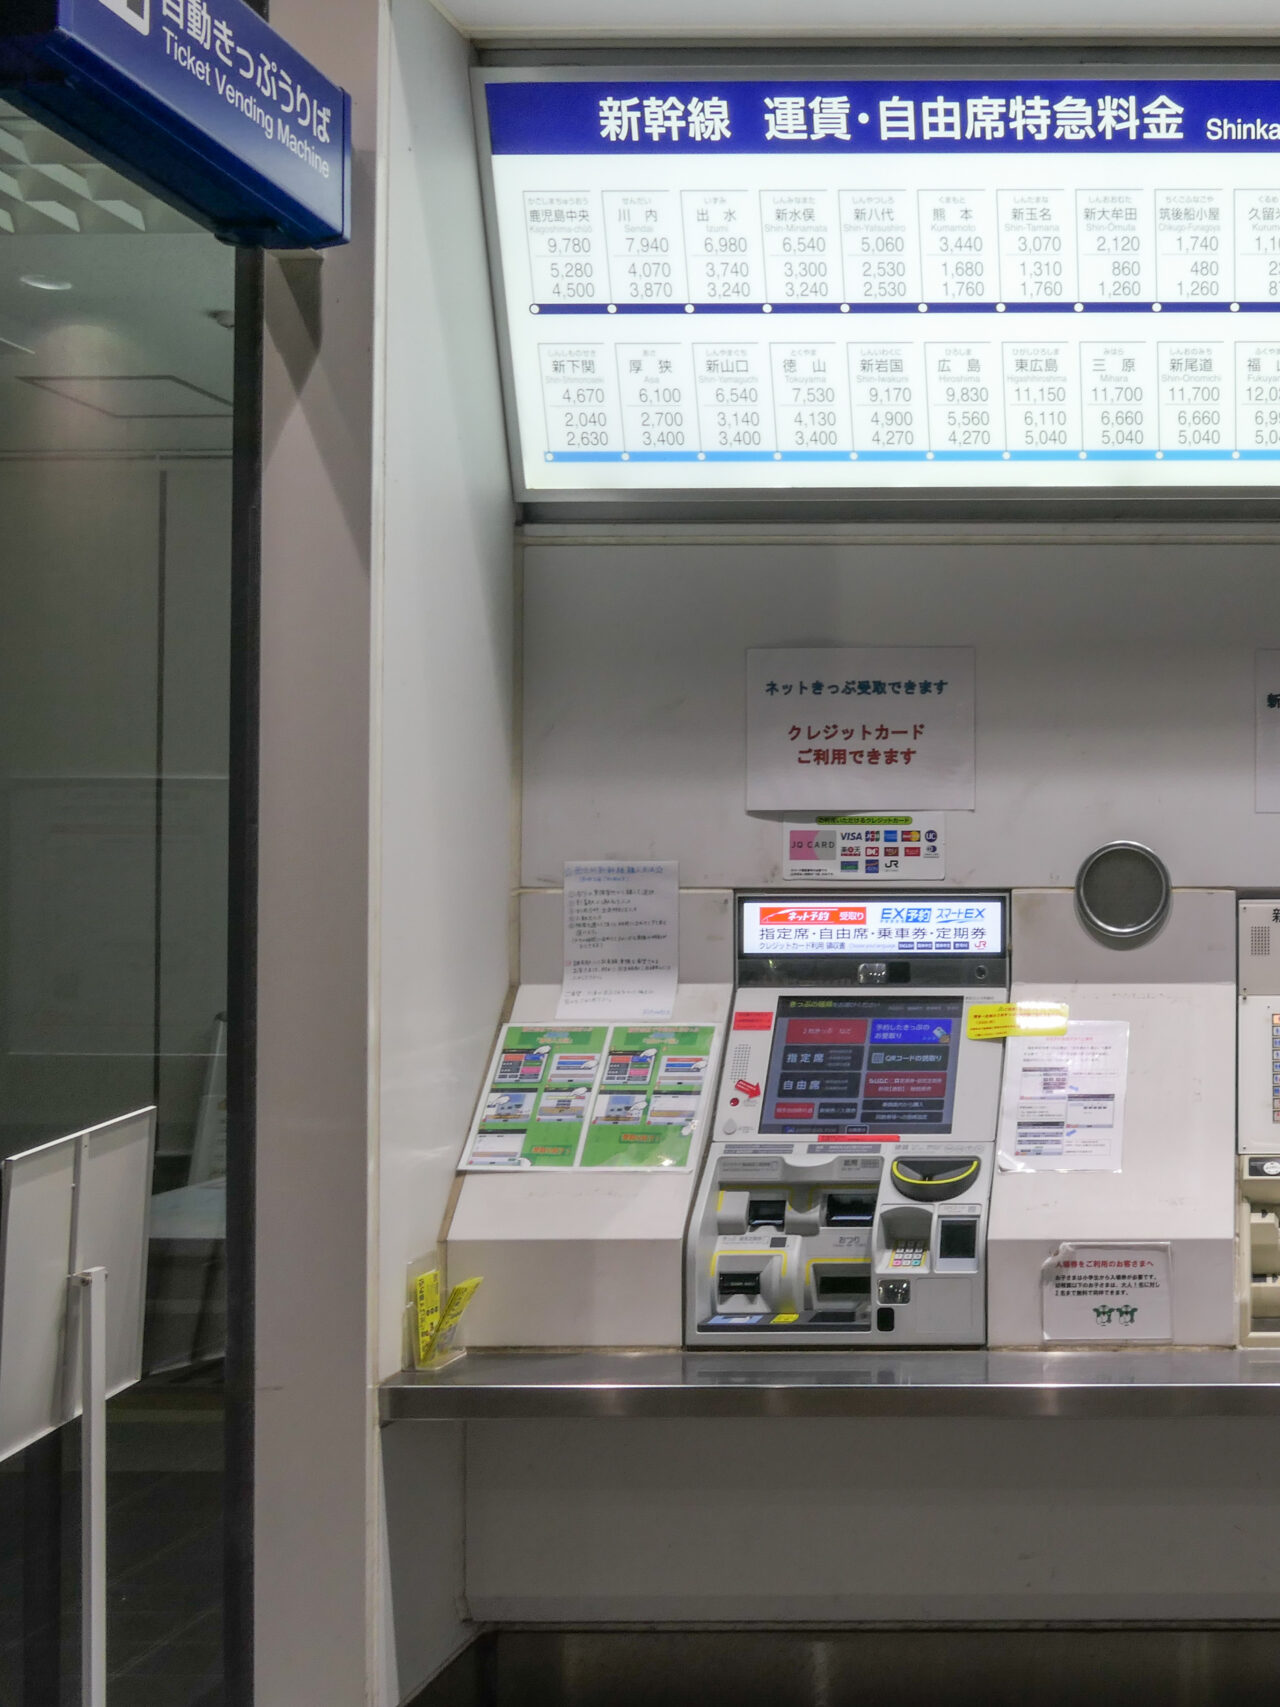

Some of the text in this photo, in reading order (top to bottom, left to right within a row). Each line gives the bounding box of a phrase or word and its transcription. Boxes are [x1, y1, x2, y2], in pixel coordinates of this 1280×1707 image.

[162, 26, 330, 179] Ticket Vending Machine
[599, 95, 1184, 141] 新幹線 運賃・自由席特急料金
[529, 208, 590, 223] 鹿児島中央
[696, 207, 737, 223] 出水
[775, 207, 816, 223] 新水俣
[853, 207, 895, 222] 新八代
[932, 207, 973, 222] 熊本
[1011, 207, 1052, 222] 新玉名
[1083, 207, 1138, 221] 新大牟田
[547, 237, 592, 254] 9,780
[624, 236, 669, 254] 7,940
[703, 236, 748, 253] 6,980
[782, 236, 827, 253] 6,540
[861, 236, 905, 253] 5,060
[939, 235, 984, 253] 3,440
[1017, 235, 1062, 253] 3,070
[1096, 235, 1141, 253] 2,120
[1176, 235, 1219, 252] 1,740
[550, 262, 594, 279] 5,280
[627, 261, 672, 278] 4,070
[705, 261, 750, 278] 3,740
[783, 261, 828, 278] 3,300
[861, 261, 906, 279] 2,530
[941, 260, 984, 278] 1,680
[1019, 260, 1063, 278] 1,310
[1111, 260, 1141, 277] 860
[1189, 260, 1220, 277] 480
[551, 359, 596, 374] 新下関
[705, 359, 749, 374] 新山口
[859, 358, 904, 373] 新岩国
[937, 358, 982, 373] 広島
[1014, 358, 1059, 373] 東広島
[1092, 357, 1136, 373] 三原
[1169, 357, 1214, 373] 新尾道
[561, 387, 605, 404] 4,670
[638, 387, 682, 404] 6,100
[715, 387, 759, 404] 6,540
[791, 386, 836, 406] 7,530
[868, 386, 912, 403] 9,170
[945, 386, 989, 403] 9,830
[1014, 386, 1067, 403] 11,150
[1091, 386, 1144, 402] 11,700
[1168, 386, 1221, 402] 11,700
[564, 411, 607, 428] 2,040
[716, 411, 760, 428] 3,140
[870, 410, 914, 428] 4,900
[1023, 410, 1067, 427] 6,110
[1177, 409, 1221, 427] 6,660
[765, 680, 949, 696] ネットきっぷ受取できます
[787, 724, 925, 741] クレジットカード
[797, 748, 917, 765] ご利用できます
[806, 841, 835, 849] CARD
[840, 832, 863, 841] VISA
[885, 860, 899, 869] JR
[788, 911, 864, 921] ネット予約 受取り
[786, 1053, 824, 1064] 指定席
[783, 1079, 821, 1091] 自由席
